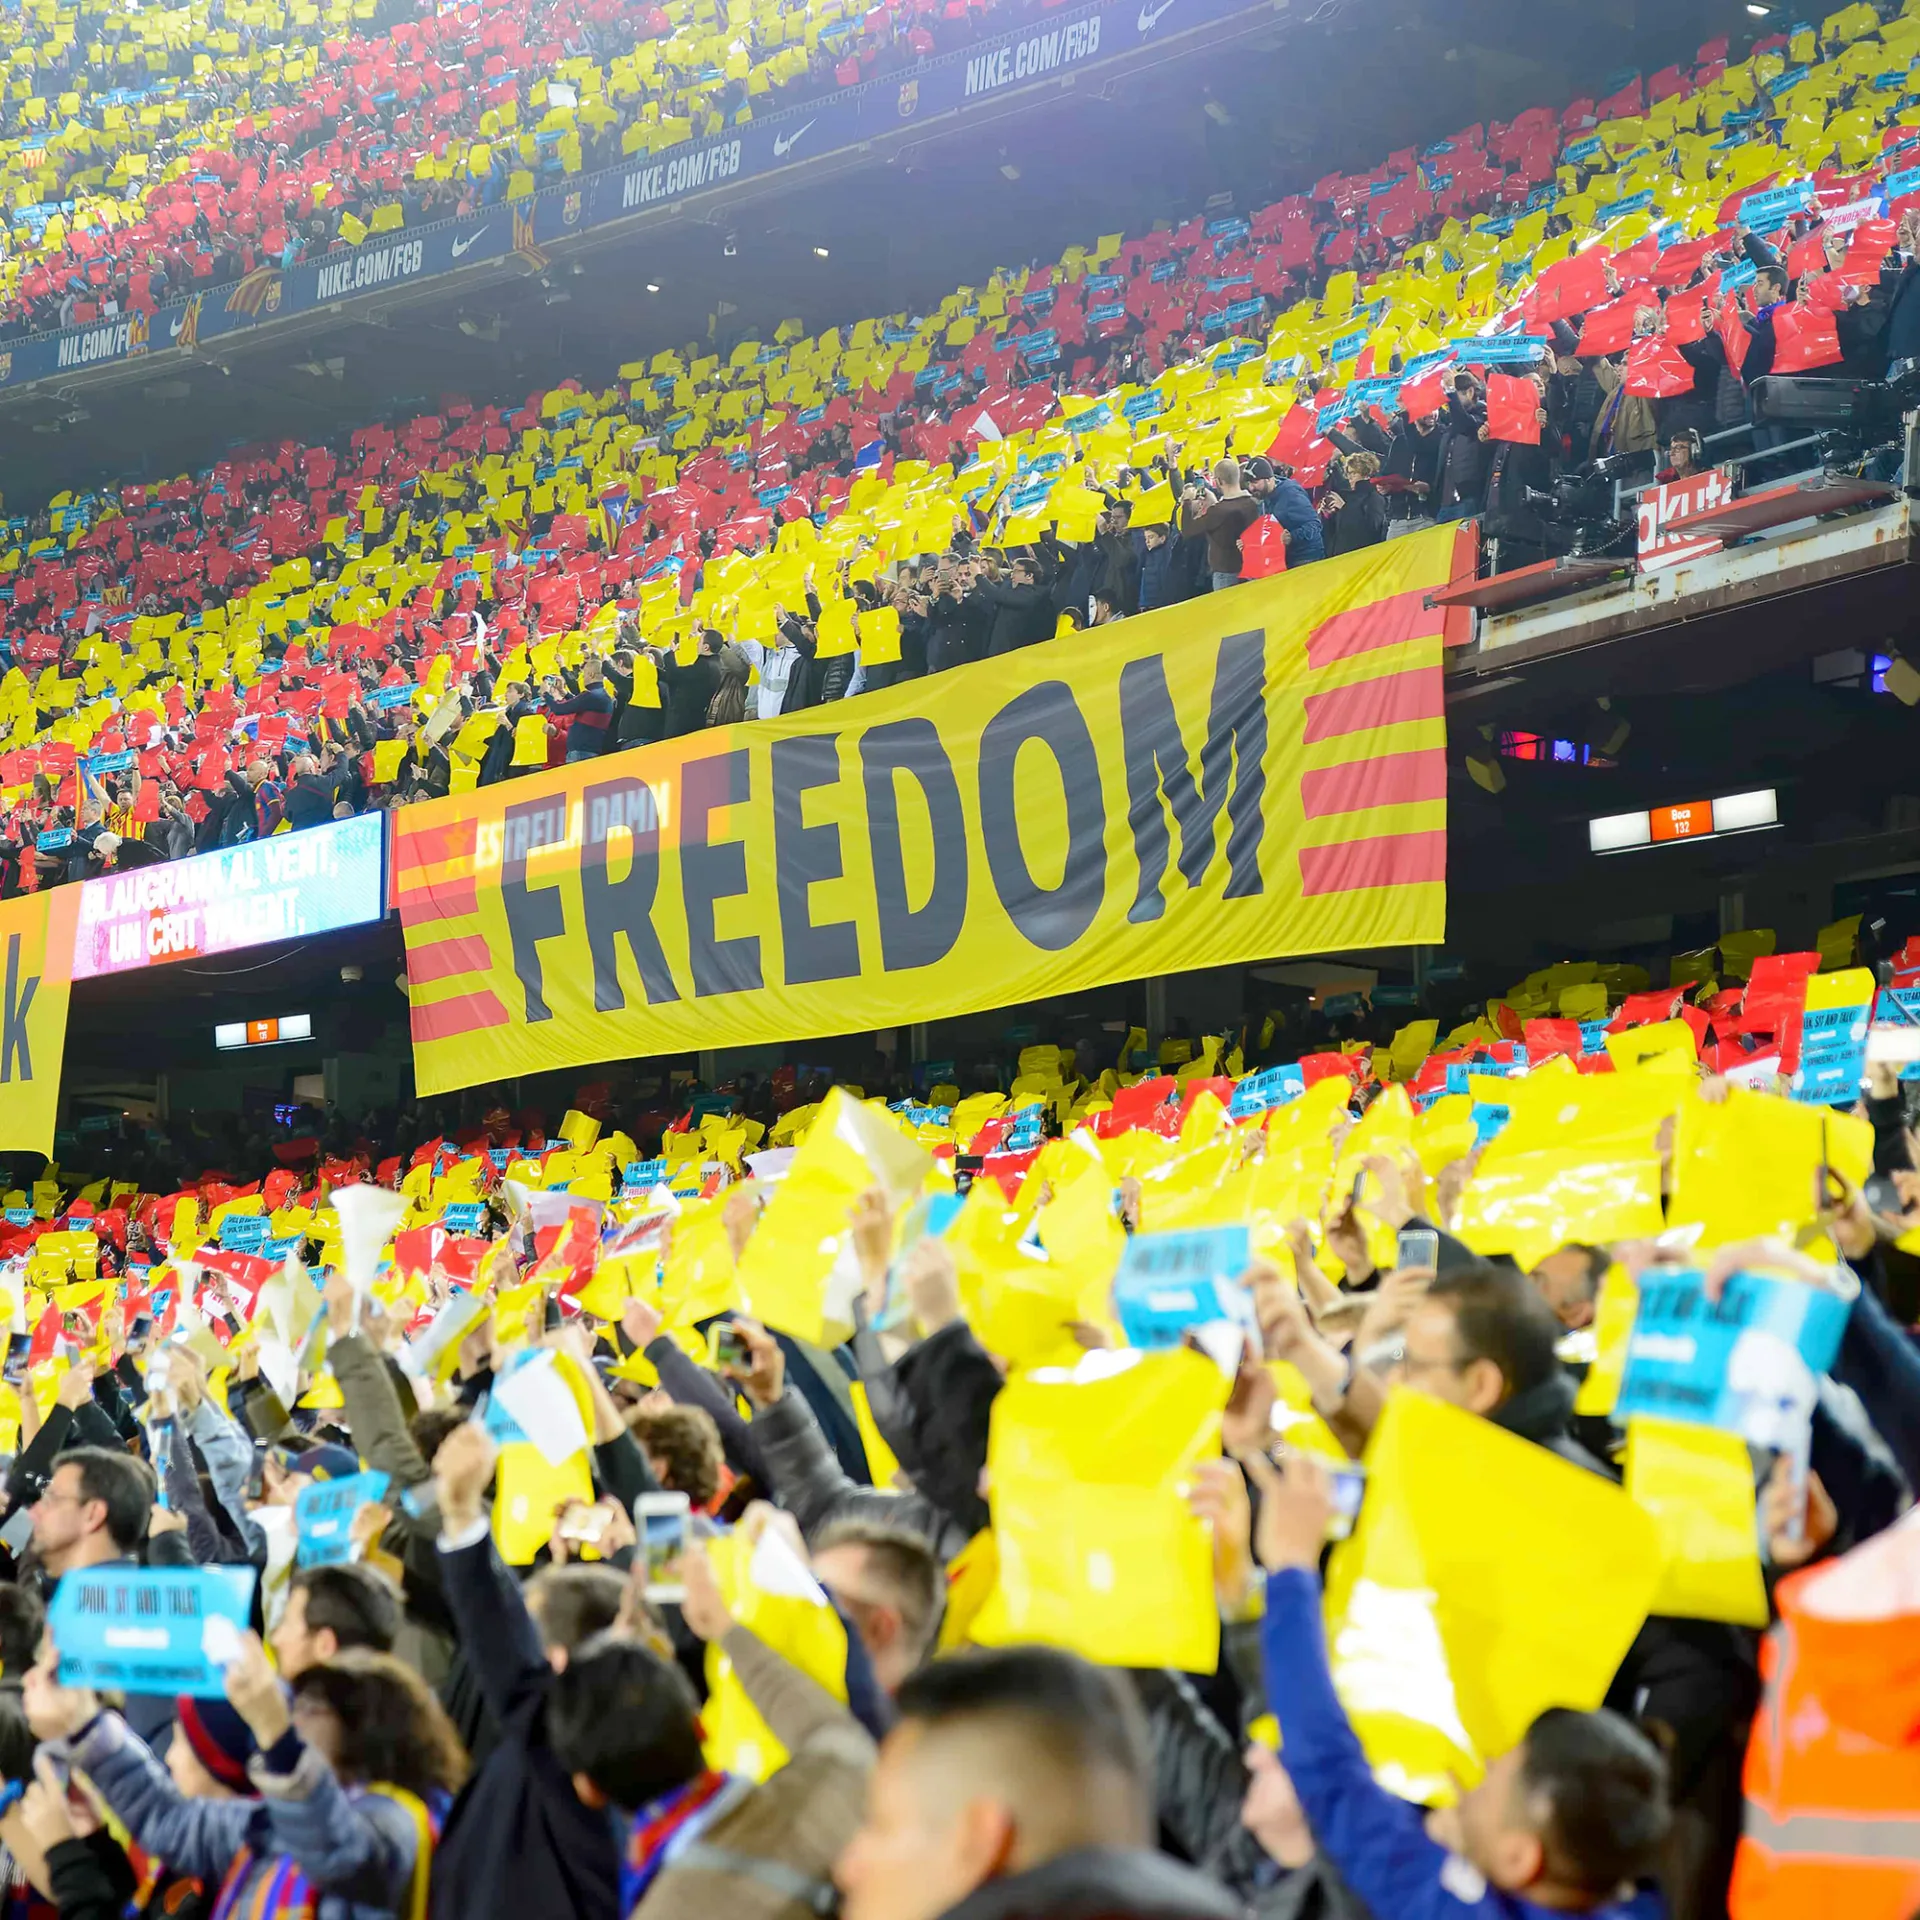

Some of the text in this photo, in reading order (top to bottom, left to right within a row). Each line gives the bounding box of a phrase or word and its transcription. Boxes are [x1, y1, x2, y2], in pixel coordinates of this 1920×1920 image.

[965, 16, 1100, 96] NIKE.COM/FCB
[622, 140, 741, 208] NIKE.COM/FCB
[1773, 190, 1785, 200] AND
[317, 239, 422, 300] NIKE.COM/FCB
[475, 781, 669, 870] ESTRELLA DAMM
[502, 628, 1266, 1023] FREEDOM
[1671, 808, 1691, 821] Boca
[1674, 821, 1690, 834] 132
[82, 857, 223, 924] BLAUGRANA
[228, 850, 261, 895] AL
[110, 921, 143, 963] UN
[146, 911, 199, 956] CRIT
[1825, 1012, 1838, 1027] AND
